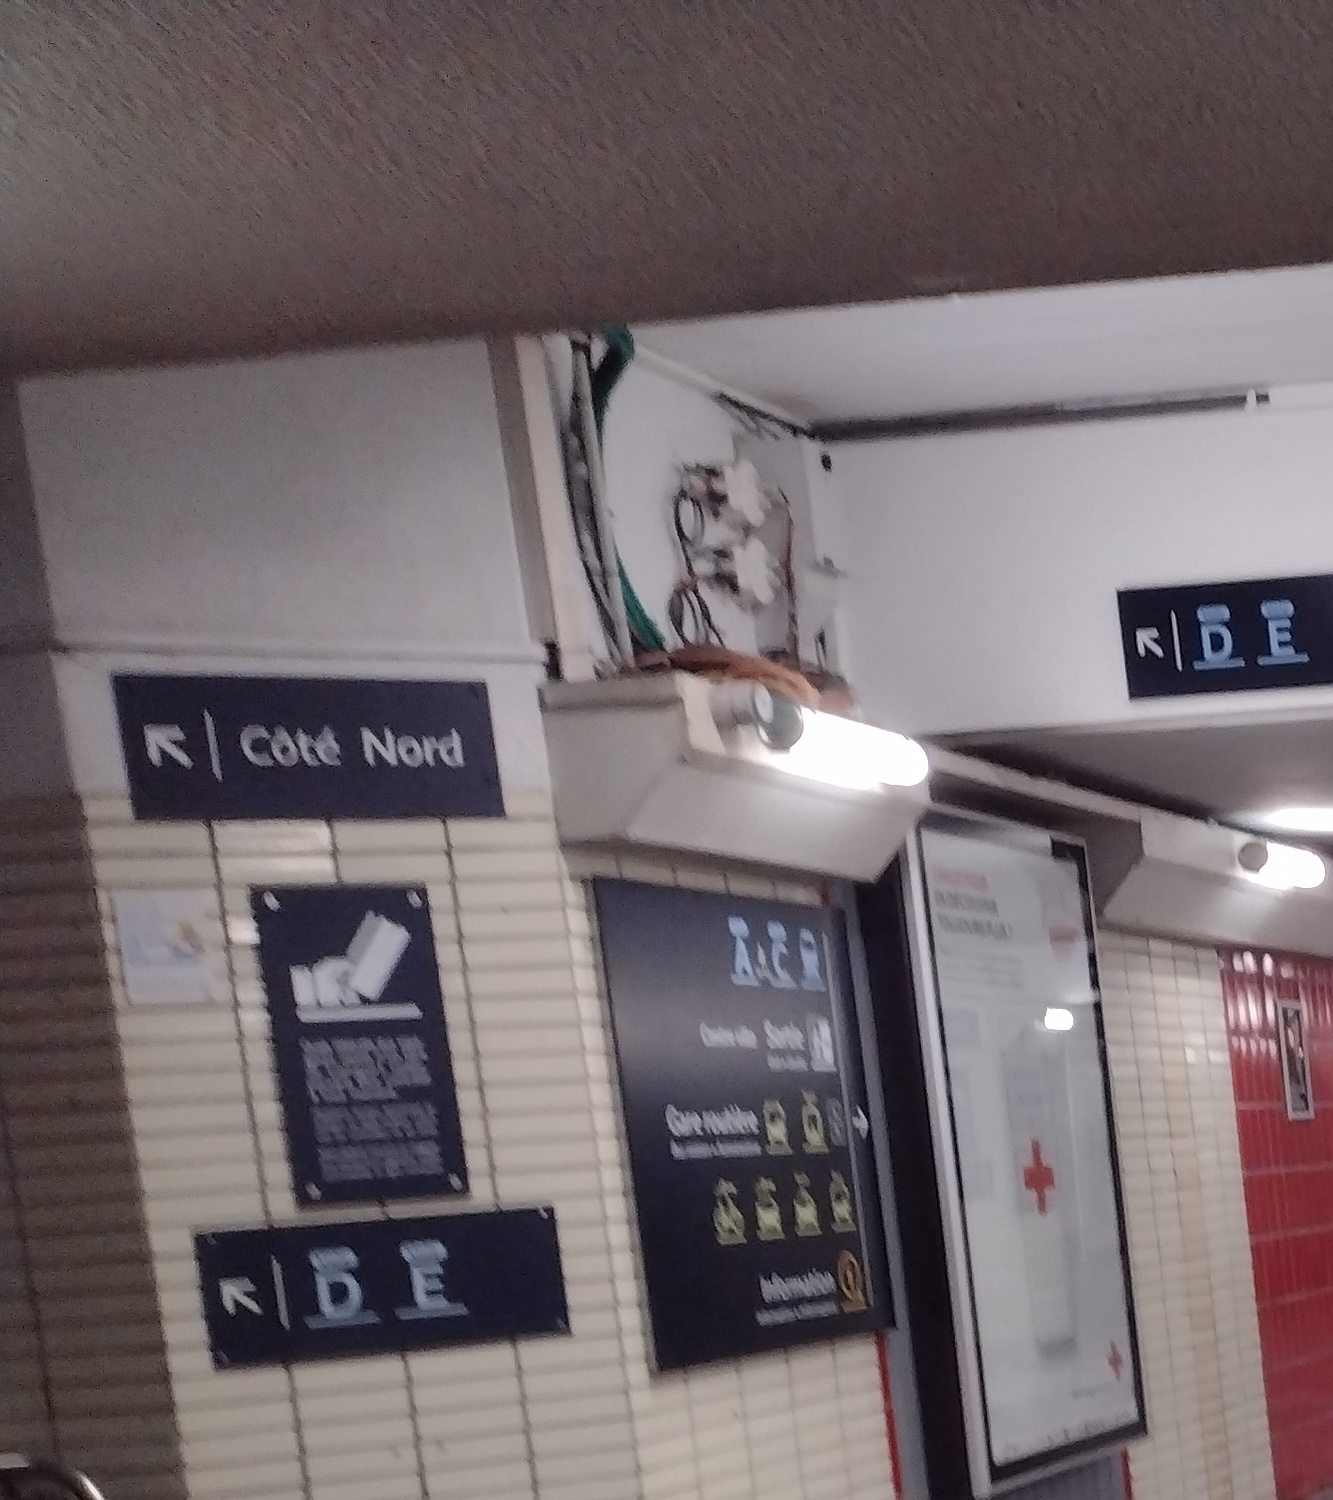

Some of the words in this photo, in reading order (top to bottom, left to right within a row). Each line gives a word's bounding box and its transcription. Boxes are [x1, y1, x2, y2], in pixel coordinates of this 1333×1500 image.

[1200, 623, 1234, 661] D
[1267, 617, 1296, 656] E
[239, 723, 342, 768] Côté
[359, 725, 465, 769] Nord
[315, 1270, 363, 1320] D
[410, 1261, 451, 1311] E
